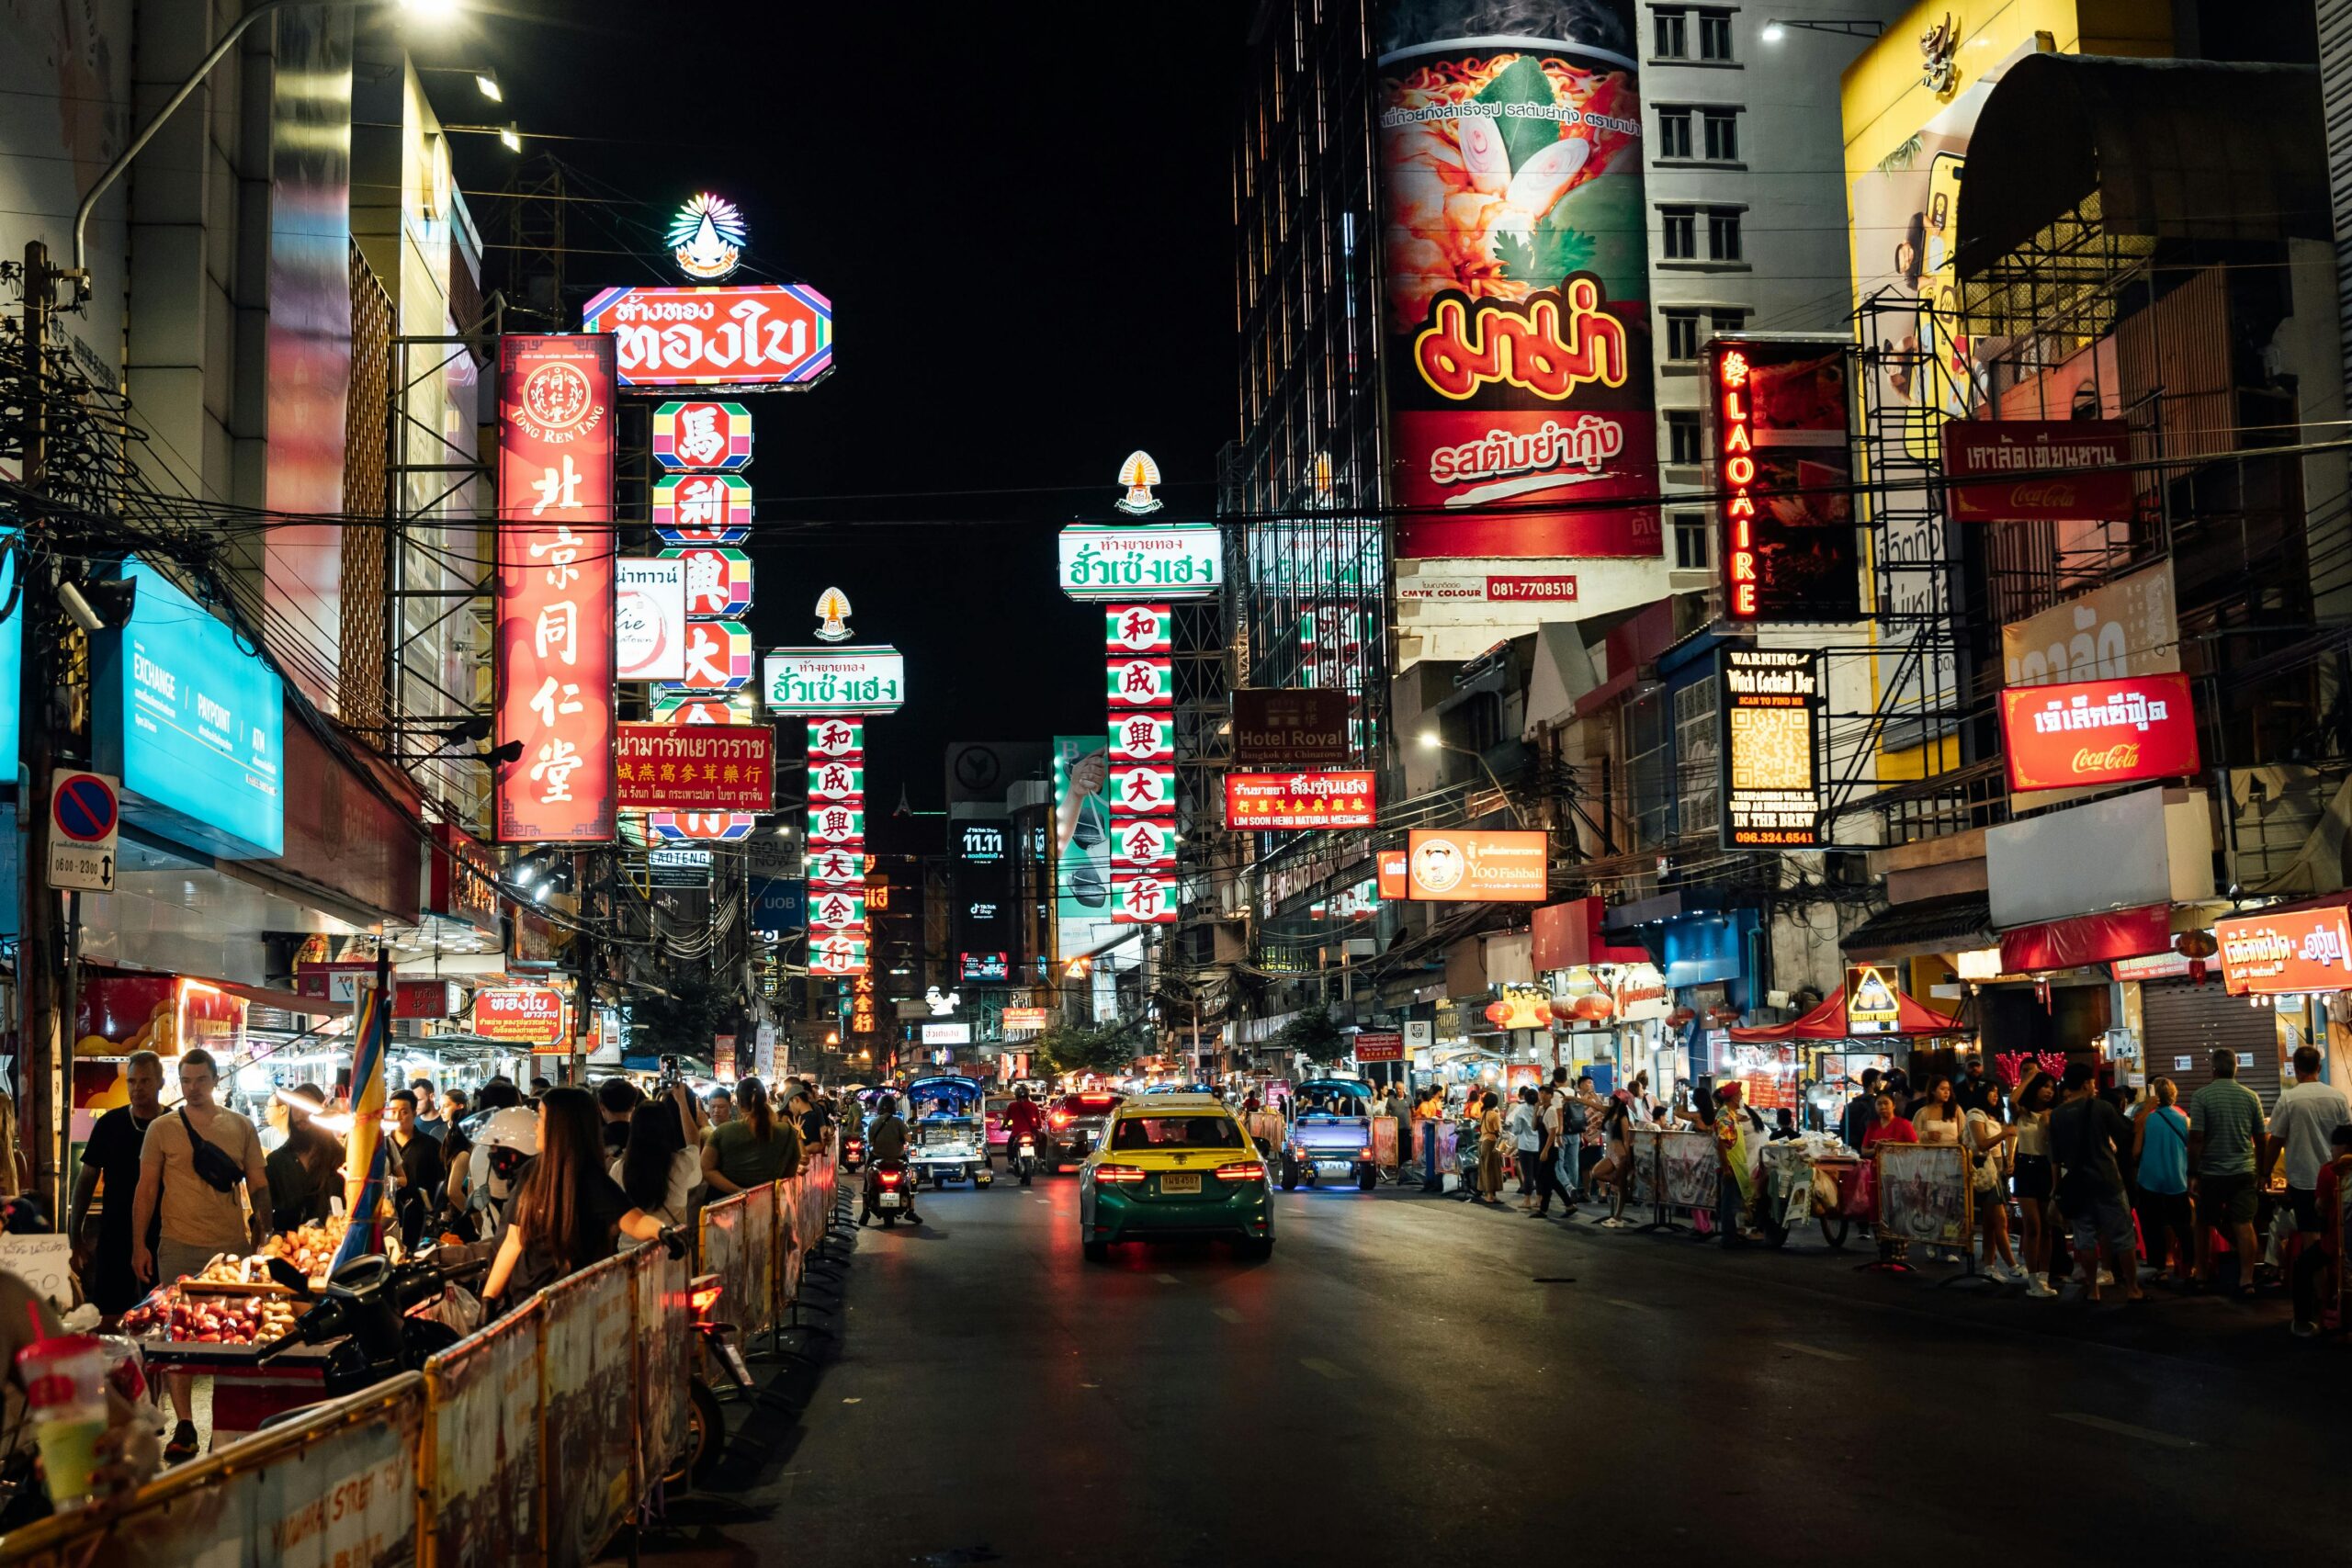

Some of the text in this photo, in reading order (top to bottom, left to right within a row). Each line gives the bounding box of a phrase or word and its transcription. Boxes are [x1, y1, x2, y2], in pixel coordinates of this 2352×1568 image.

[1506, 102, 1580, 127] รสต้มยำกุ้ง
[616, 296, 715, 321] ห้างทอง
[616, 299, 808, 371] ทองใบ
[1415, 278, 1627, 400] มาม่า
[511, 405, 605, 444] TONG REN TANG
[1430, 415, 1623, 484] รสต้มยำกุ้ง
[1101, 536, 1182, 551] ห้างขายทอง
[1069, 543, 1213, 585] ฮั่วเซ่งเฮง
[1491, 582, 1574, 596] 081-7708518
[530, 455, 583, 804] 北京同仁堂
[799, 660, 865, 672] ห้างขายทอง
[1730, 652, 1798, 666] WARNING
[773, 666, 897, 703] ฮั่วเซ่งเฮง
[1726, 669, 1815, 694] Witch Cocktail Bar
[134, 652, 175, 702] EXCHANGE
[198, 693, 231, 734] PAYPOINT
[253, 727, 266, 754] ATM
[1738, 696, 1804, 705] SCAN TO FIND ME
[1239, 729, 1342, 748] Hotel Royal
[1124, 611, 1159, 915] 和成興大金行
[1241, 750, 1279, 761] Bangkok
[1295, 750, 1343, 759] Chinatown
[1729, 801, 1819, 812] USED AS INGREDIENTS
[1234, 814, 1370, 826] LIM SOON HENG NATURAL MEDICINE
[1734, 812, 1815, 827] IN THE BREW
[963, 834, 1002, 852] 11.11
[1736, 831, 1814, 843] 096.324.6541
[821, 724, 852, 971] 和成興大金行
[1499, 866, 1544, 879] Fishball
[764, 897, 796, 908] UOB
[491, 992, 548, 1010] ทองใบ
